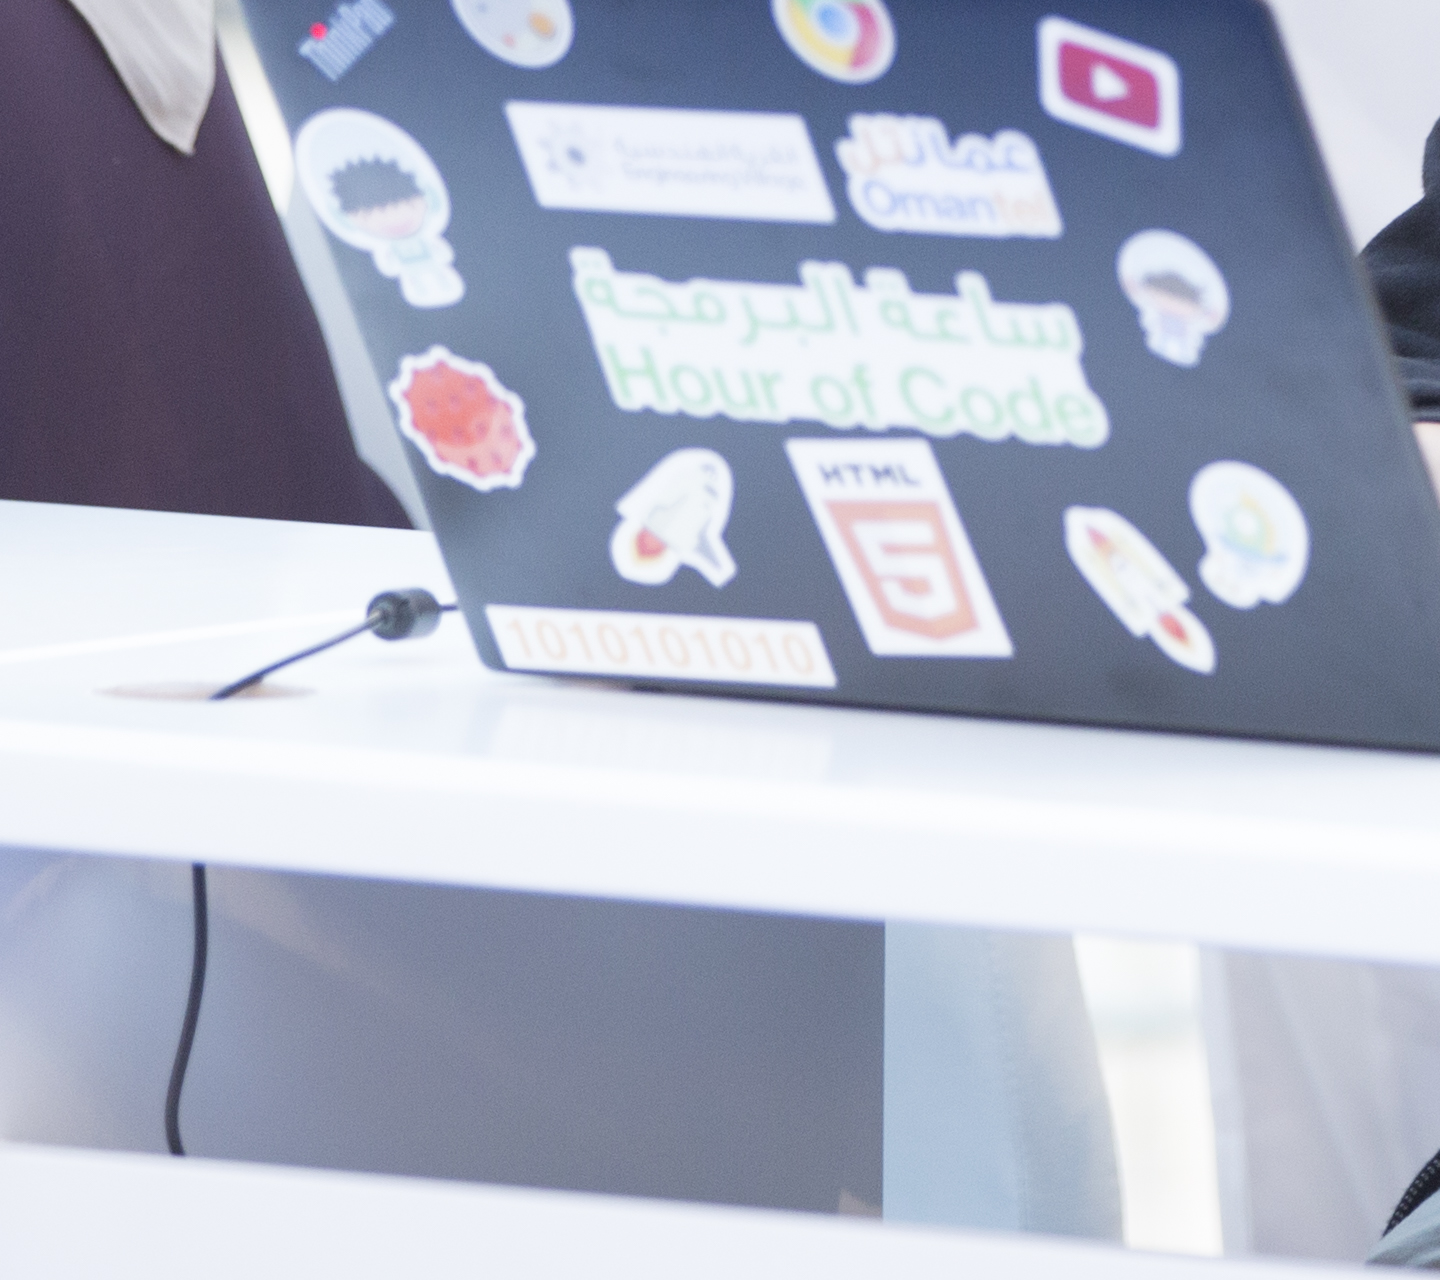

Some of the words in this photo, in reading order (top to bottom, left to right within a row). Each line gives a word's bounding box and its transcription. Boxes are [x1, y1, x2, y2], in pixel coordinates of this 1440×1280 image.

[605, 342, 782, 412] Hour
[810, 364, 878, 420] of
[900, 366, 1096, 438] Code
[818, 462, 924, 489] HTML
[506, 617, 817, 676] 1010101010
